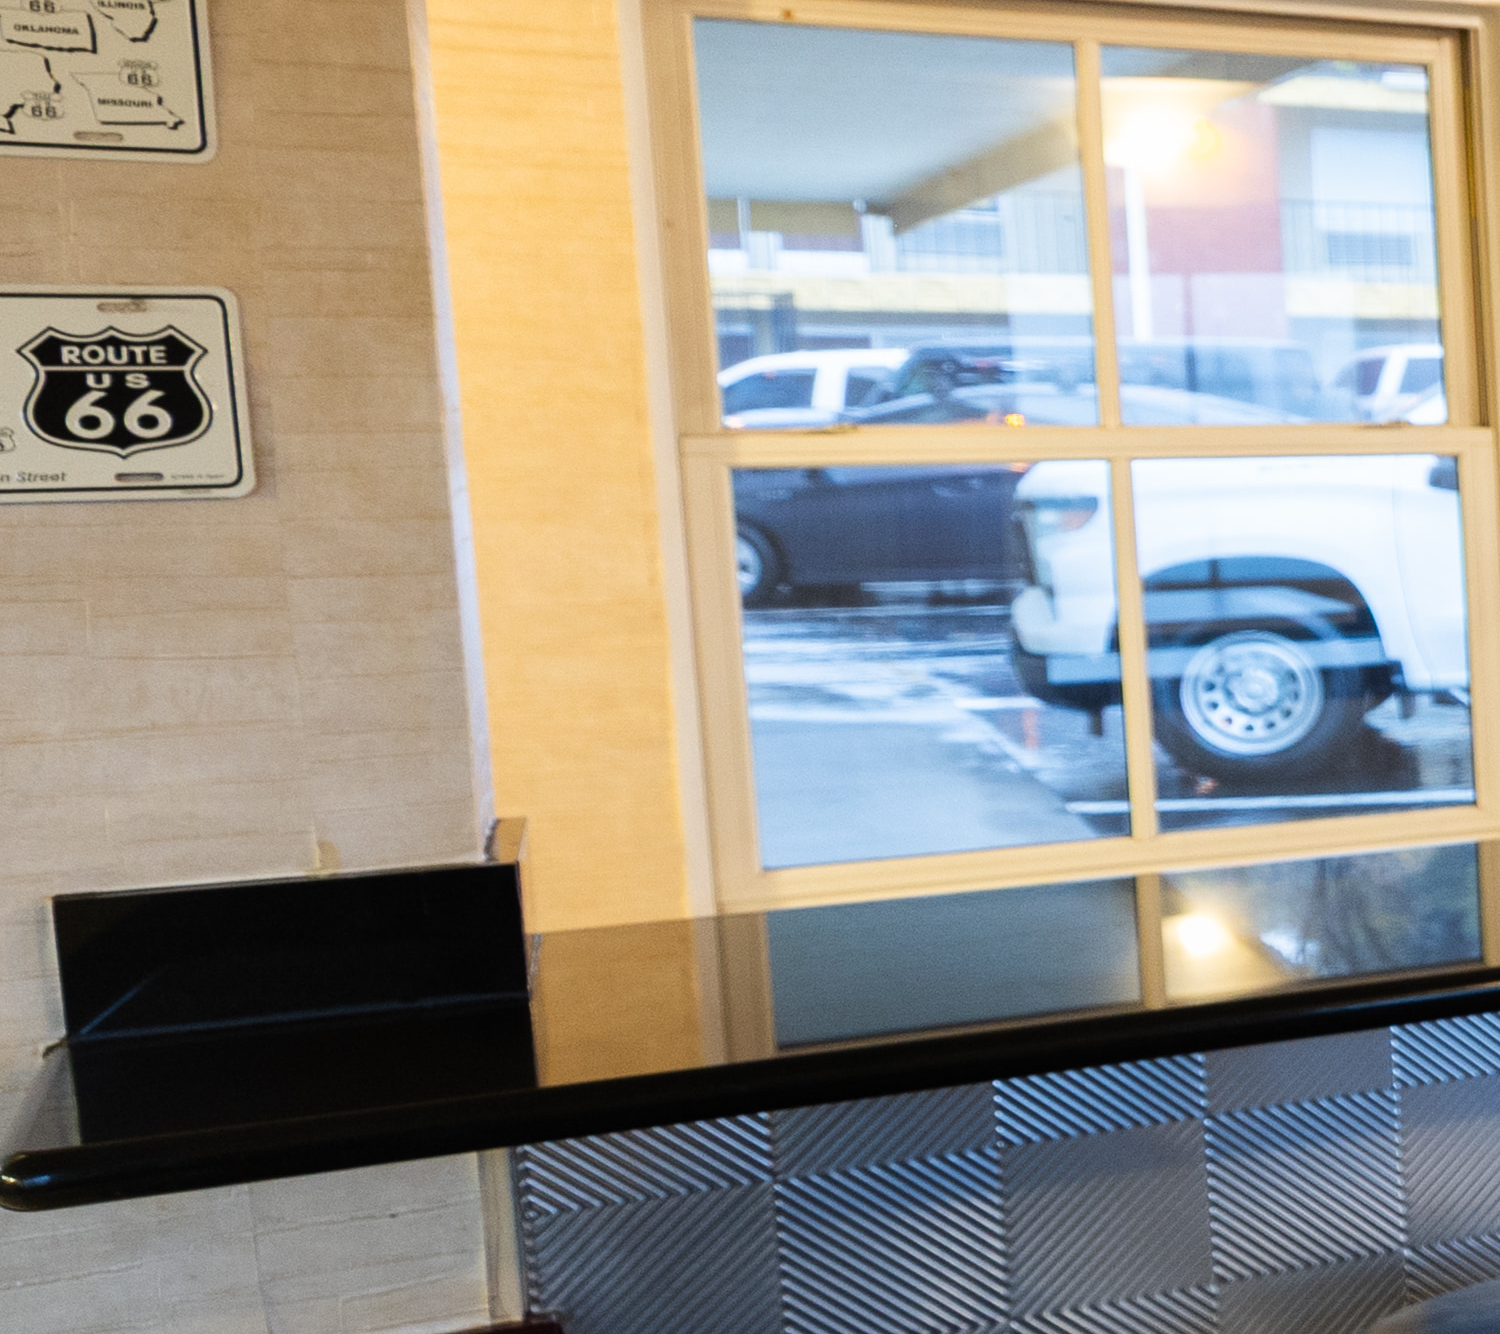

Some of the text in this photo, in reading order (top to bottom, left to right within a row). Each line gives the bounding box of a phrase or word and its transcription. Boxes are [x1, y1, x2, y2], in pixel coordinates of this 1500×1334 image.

[14, 23, 80, 35] OKLAHOMA
[97, 97, 153, 108] MISSOURI
[61, 345, 168, 364] ROUTE
[65, 390, 173, 439] 66
[17, 472, 66, 483] Street
